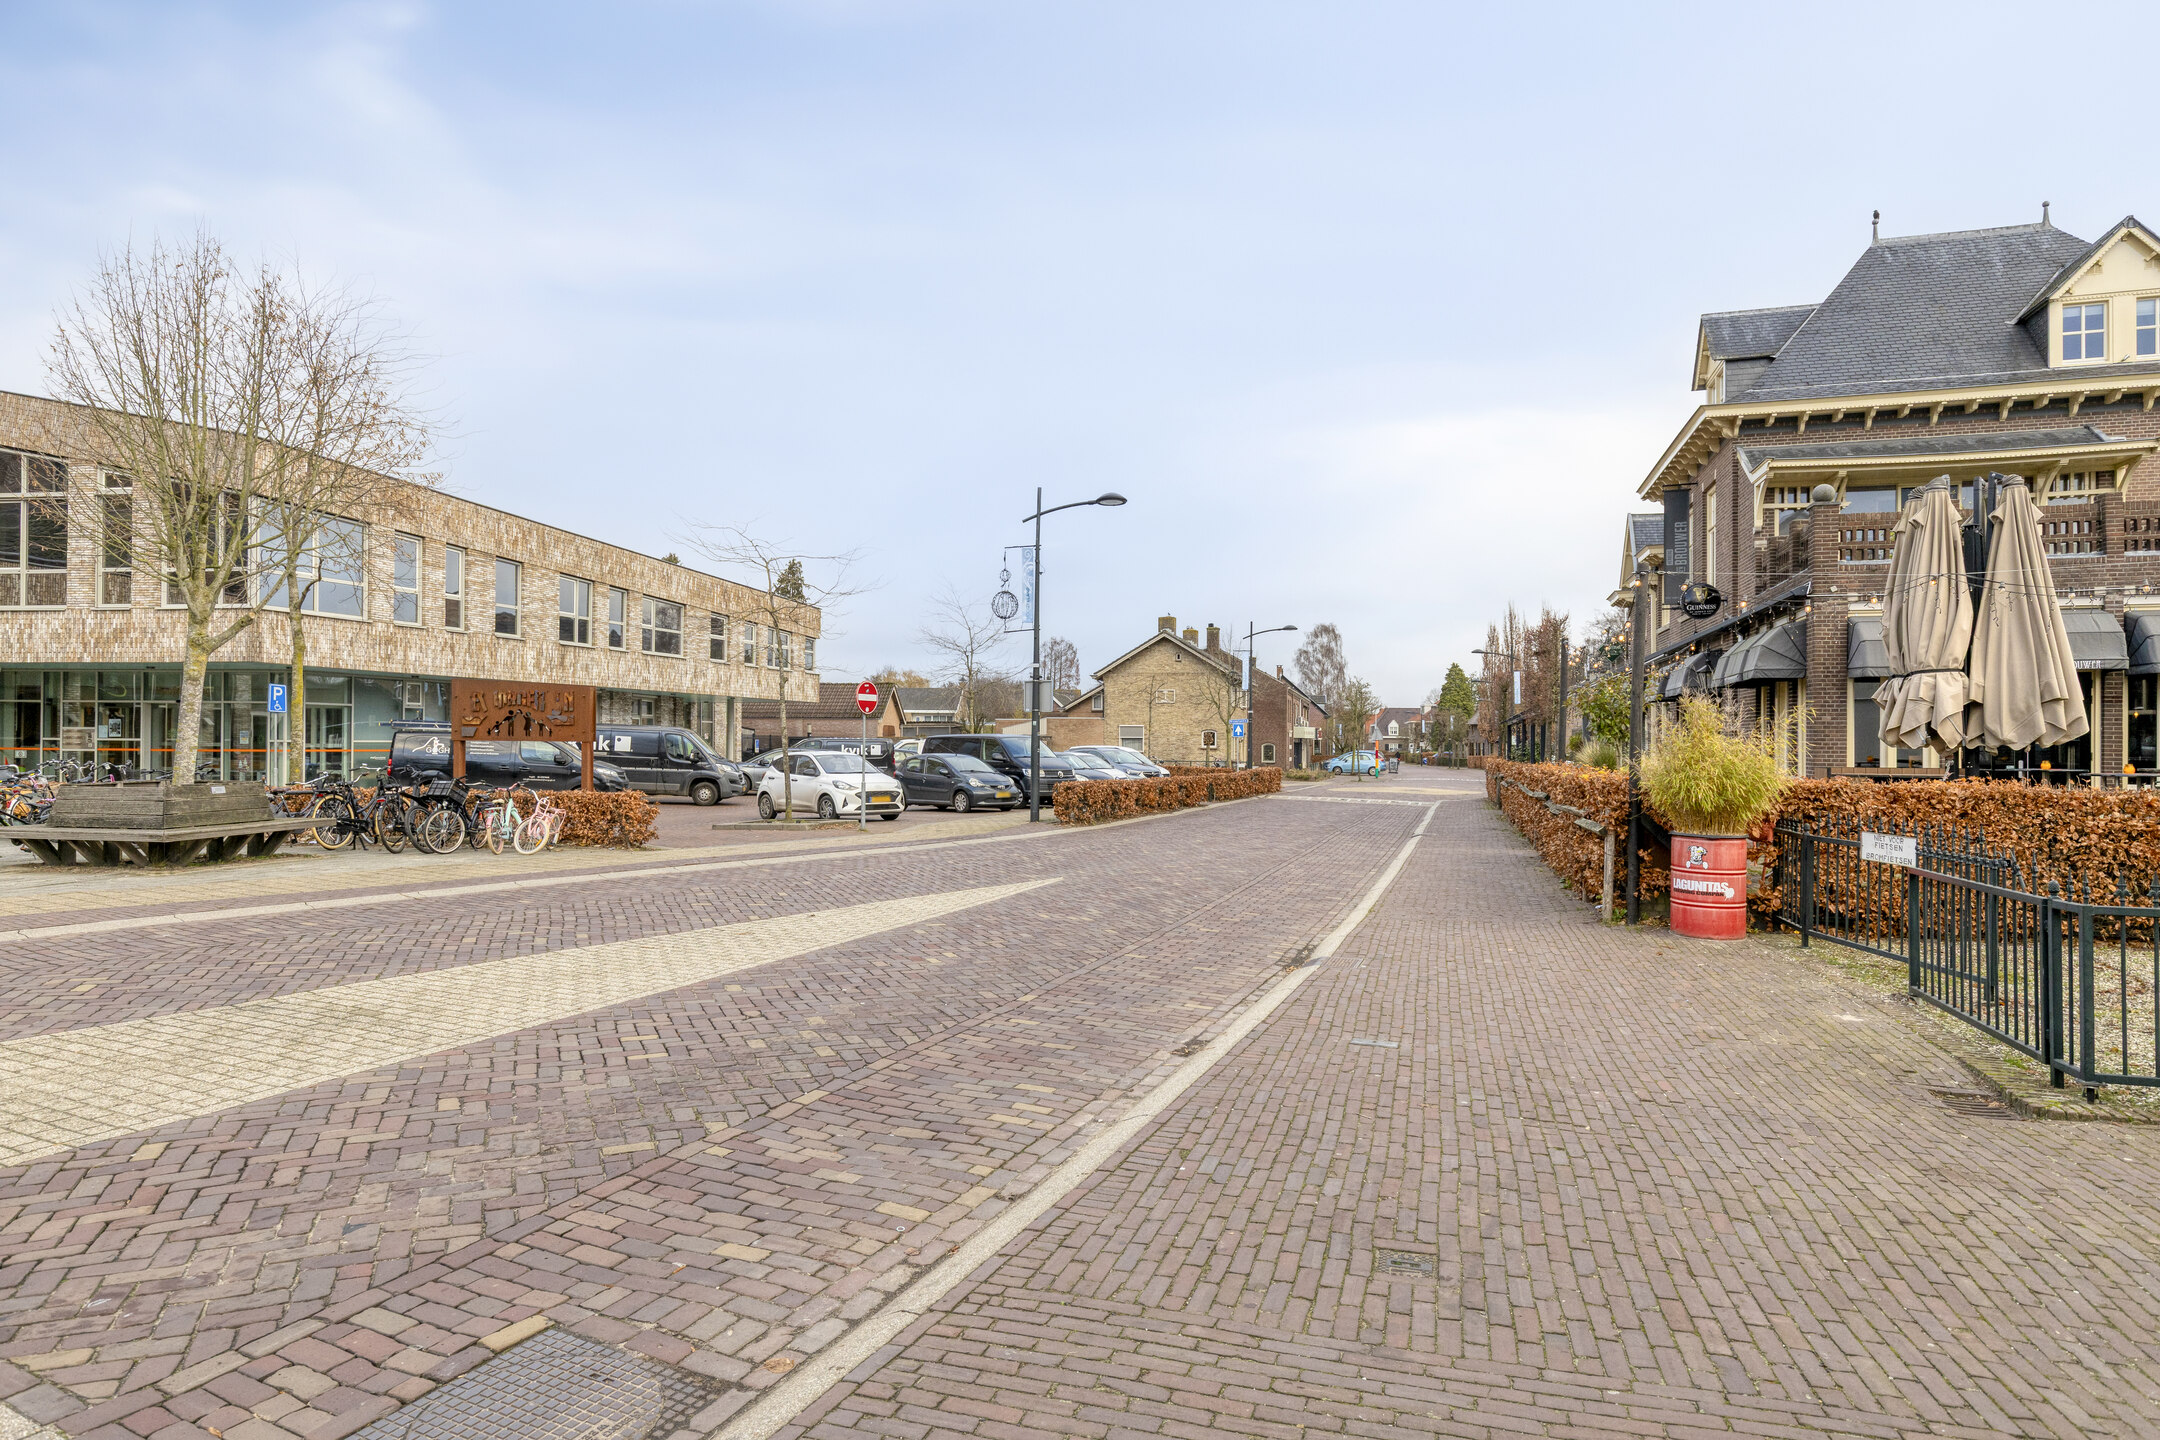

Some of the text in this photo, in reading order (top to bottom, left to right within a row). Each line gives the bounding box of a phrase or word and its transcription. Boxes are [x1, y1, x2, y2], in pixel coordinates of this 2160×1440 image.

[1674, 521, 1687, 566] BROUWER
[1686, 603, 1717, 611] GUINNESS
[273, 686, 283, 701] P
[842, 744, 868, 755] kvik
[1873, 834, 1904, 845] NIET VOOR
[1874, 841, 1904, 852] FIETSEN
[1865, 852, 1913, 866] BROMFIETSEN
[1673, 877, 1729, 894] LAGUNITAS
